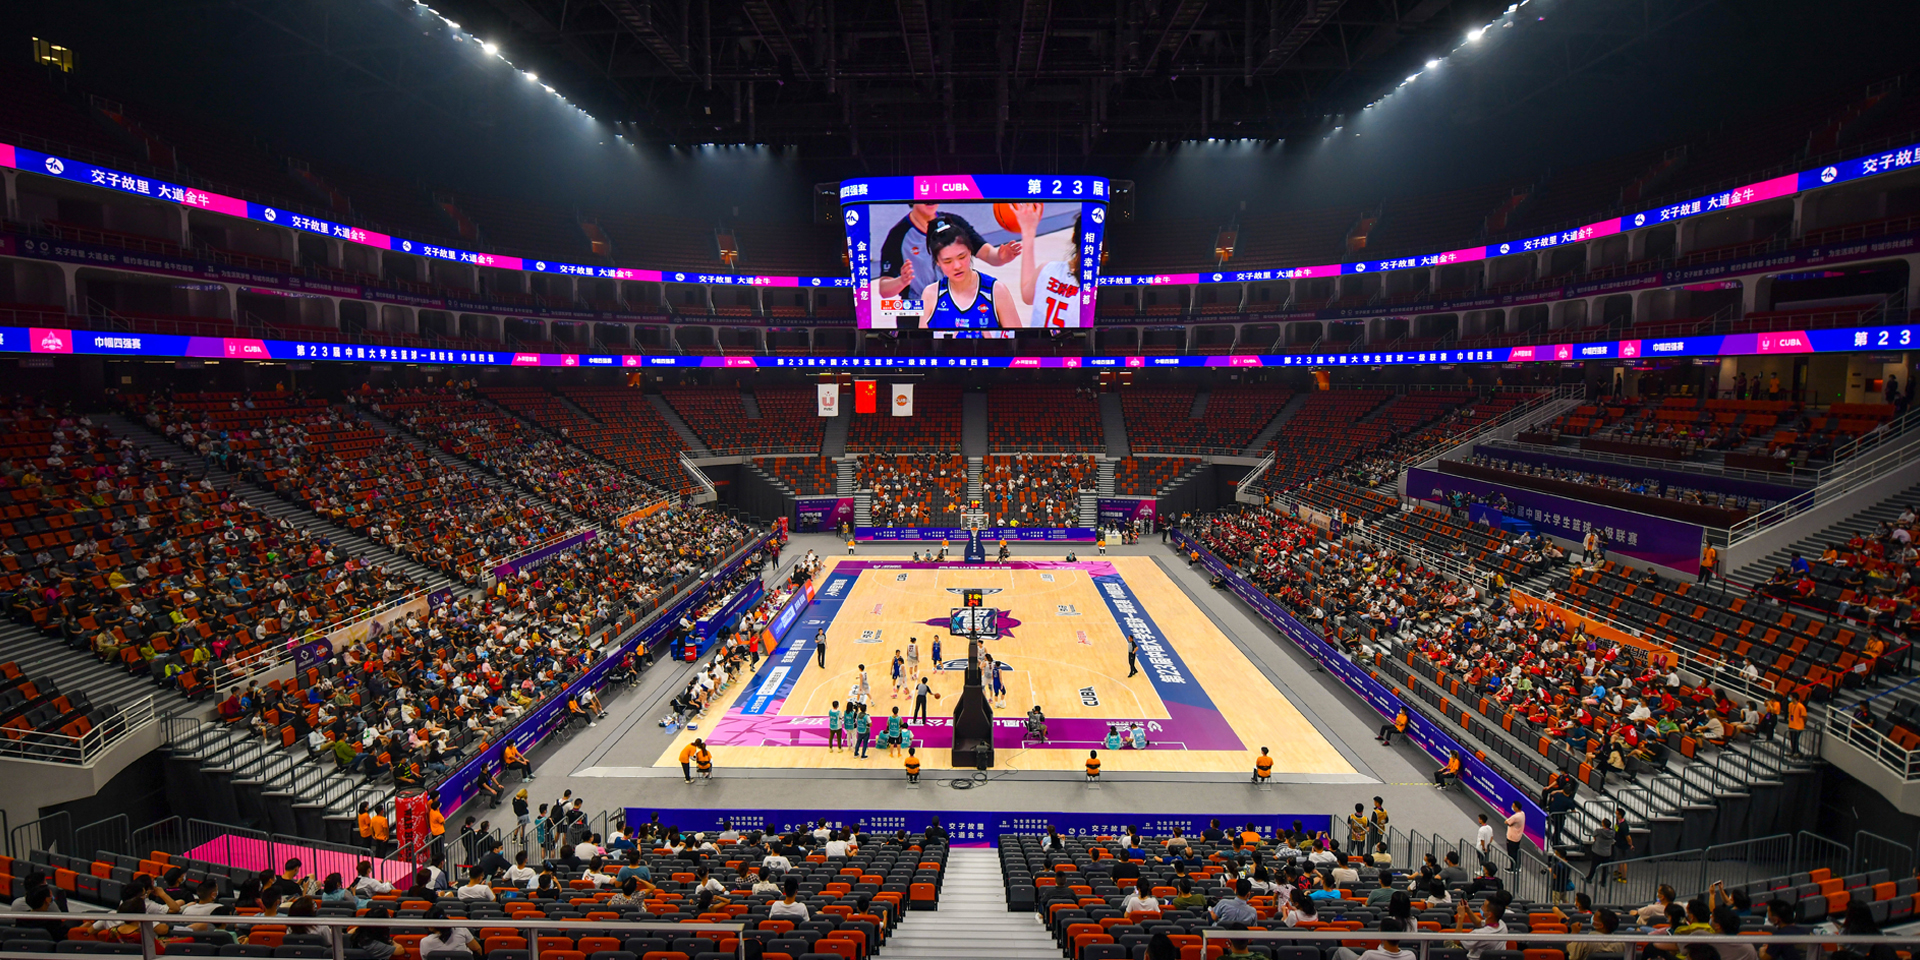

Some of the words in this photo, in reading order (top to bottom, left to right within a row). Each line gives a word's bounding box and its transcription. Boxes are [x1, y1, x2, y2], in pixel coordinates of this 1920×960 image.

[91, 169, 151, 195] 交子故里
[158, 184, 210, 207] 大道金牛
[942, 182, 970, 192] CUBA
[1027, 178, 1104, 197] 第23届
[1660, 200, 1701, 222] 交子故里
[1706, 188, 1755, 211] 大道金牛
[291, 215, 329, 234] 交子故里
[333, 225, 366, 242] 大道金牛
[1523, 235, 1557, 251] 交子故里
[1560, 226, 1595, 244] 大道金牛
[423, 245, 457, 260] 交子故里
[460, 252, 495, 266] 大道金牛
[1380, 258, 1416, 271] 交子故里
[1420, 253, 1457, 267] 大道金牛
[559, 264, 594, 276] 交子故里
[598, 268, 634, 279] 大道金牛
[856, 240, 869, 301] 金牛欢迎您
[1082, 231, 1096, 306] 相约幸福成都
[1236, 271, 1271, 282] 交子故里
[1276, 268, 1312, 279] 大道金牛
[94, 336, 142, 350] 巾帼四强赛
[243, 345, 262, 353] CUBA
[1779, 338, 1802, 347] CUBA
